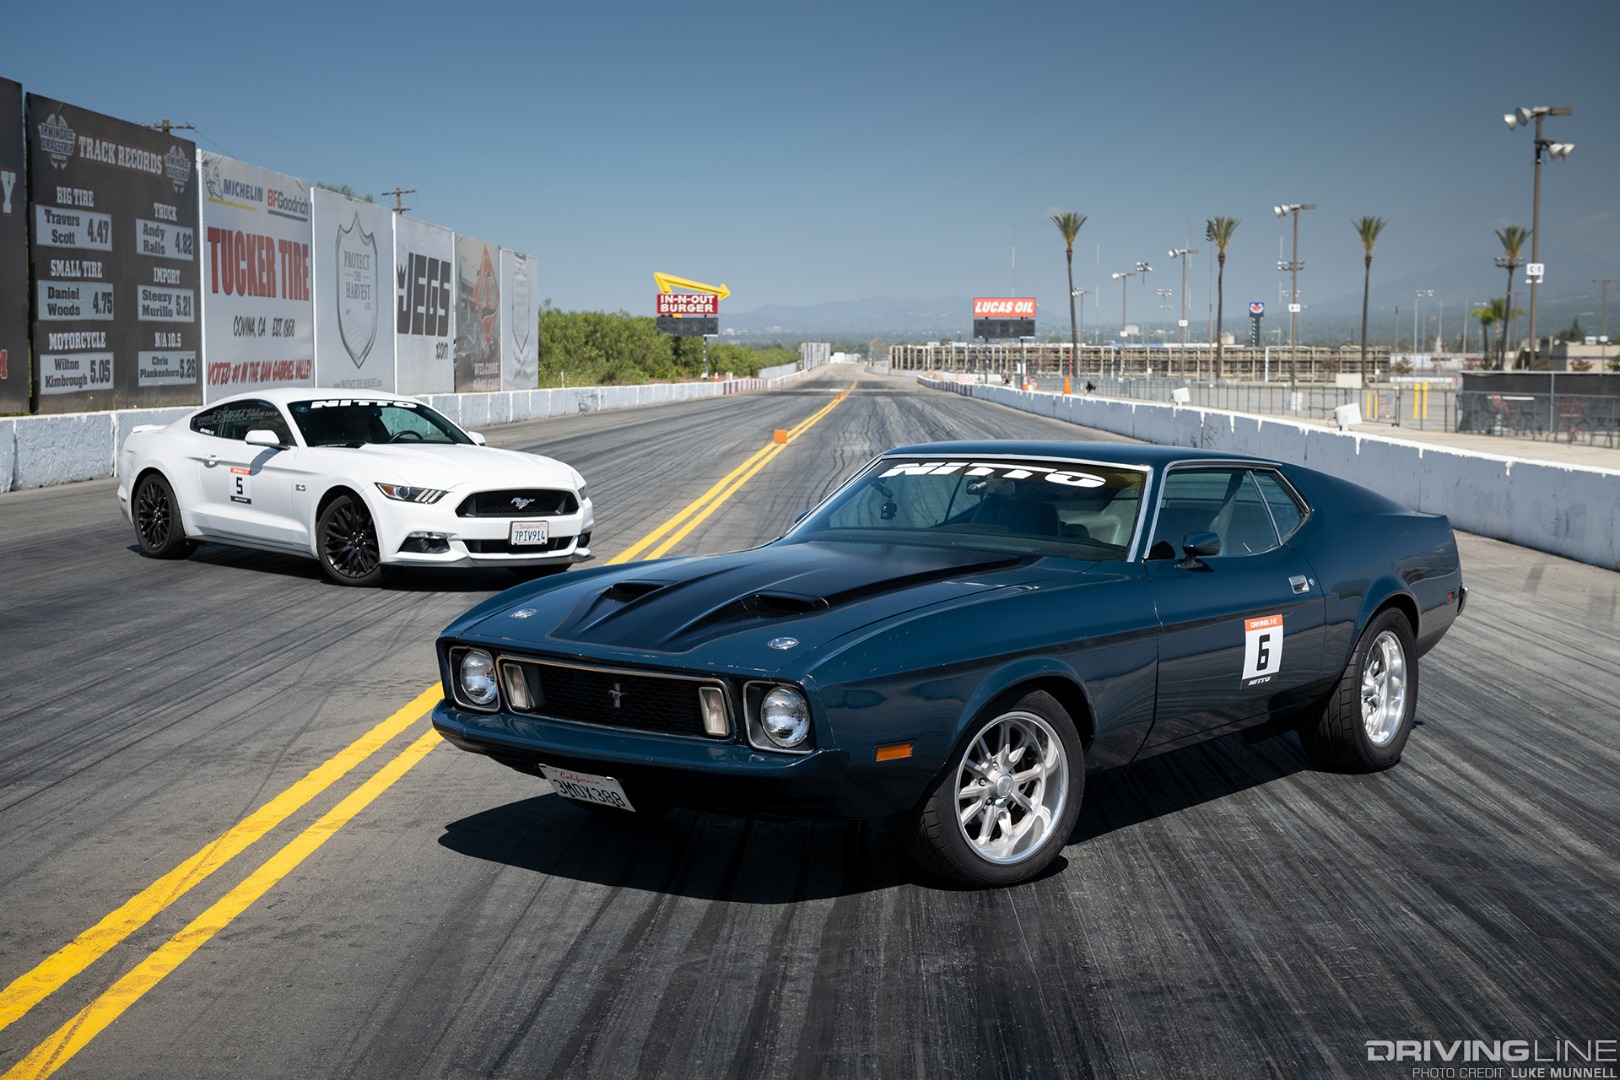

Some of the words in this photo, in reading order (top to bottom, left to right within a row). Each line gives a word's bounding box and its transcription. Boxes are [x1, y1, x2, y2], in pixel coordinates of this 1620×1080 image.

[79, 136, 116, 166] TRACK
[118, 146, 162, 175] RECORDS
[56, 186, 73, 204] BIG
[73, 188, 94, 207] TIRE
[223, 179, 263, 203] MICHELIN
[268, 188, 309, 217] BFGoodrich
[44, 210, 80, 227] Travers
[154, 203, 177, 221] TRUCK
[52, 229, 75, 245] Scott
[87, 218, 109, 244] 4.47
[143, 223, 165, 242] Andy
[143, 240, 165, 255] Ralls
[175, 232, 192, 255] 4.82
[51, 260, 81, 278] SMALL
[82, 261, 102, 278] TIRE
[207, 227, 277, 298] TUCKER
[279, 239, 309, 301] TIRE
[344, 250, 370, 270] PROTECT
[154, 267, 180, 284] IMPORT
[47, 287, 79, 300] Daniel
[142, 289, 172, 304] Steezy
[346, 282, 371, 300] HARVEST
[396, 252, 451, 337] JEGS
[660, 295, 715, 304] IN-N-OUT
[47, 303, 80, 316] Woods
[93, 292, 112, 315] 4.75
[142, 304, 172, 317] Murillo
[175, 295, 191, 317] 5.21
[660, 304, 714, 313] BURGER
[975, 301, 1013, 314] LUCAS
[1014, 301, 1034, 314] OIL
[258, 316, 266, 337] CA
[49, 332, 106, 350] MOTORCYCLE
[155, 332, 167, 348] N/A
[168, 332, 181, 348] 10.5
[54, 358, 79, 371] Wilton
[151, 356, 168, 366] Chris
[180, 359, 196, 379] 5.26
[90, 360, 111, 384] 5.05
[140, 367, 180, 379] Plankenhorn
[207, 362, 231, 385] VOTED
[249, 361, 260, 383] THE
[272, 360, 294, 381] GABRIEL
[295, 359, 312, 380] VALLEY
[45, 374, 87, 389] Kimbrough
[311, 400, 417, 408] NITTO
[878, 462, 1106, 488] NITTO
[236, 477, 243, 495] 5
[514, 531, 546, 541] 7PIV914
[1250, 618, 1278, 629] DRIVINGLINE
[1257, 634, 1270, 671] 6
[1248, 676, 1271, 686] NITTO
[560, 771, 605, 787] California
